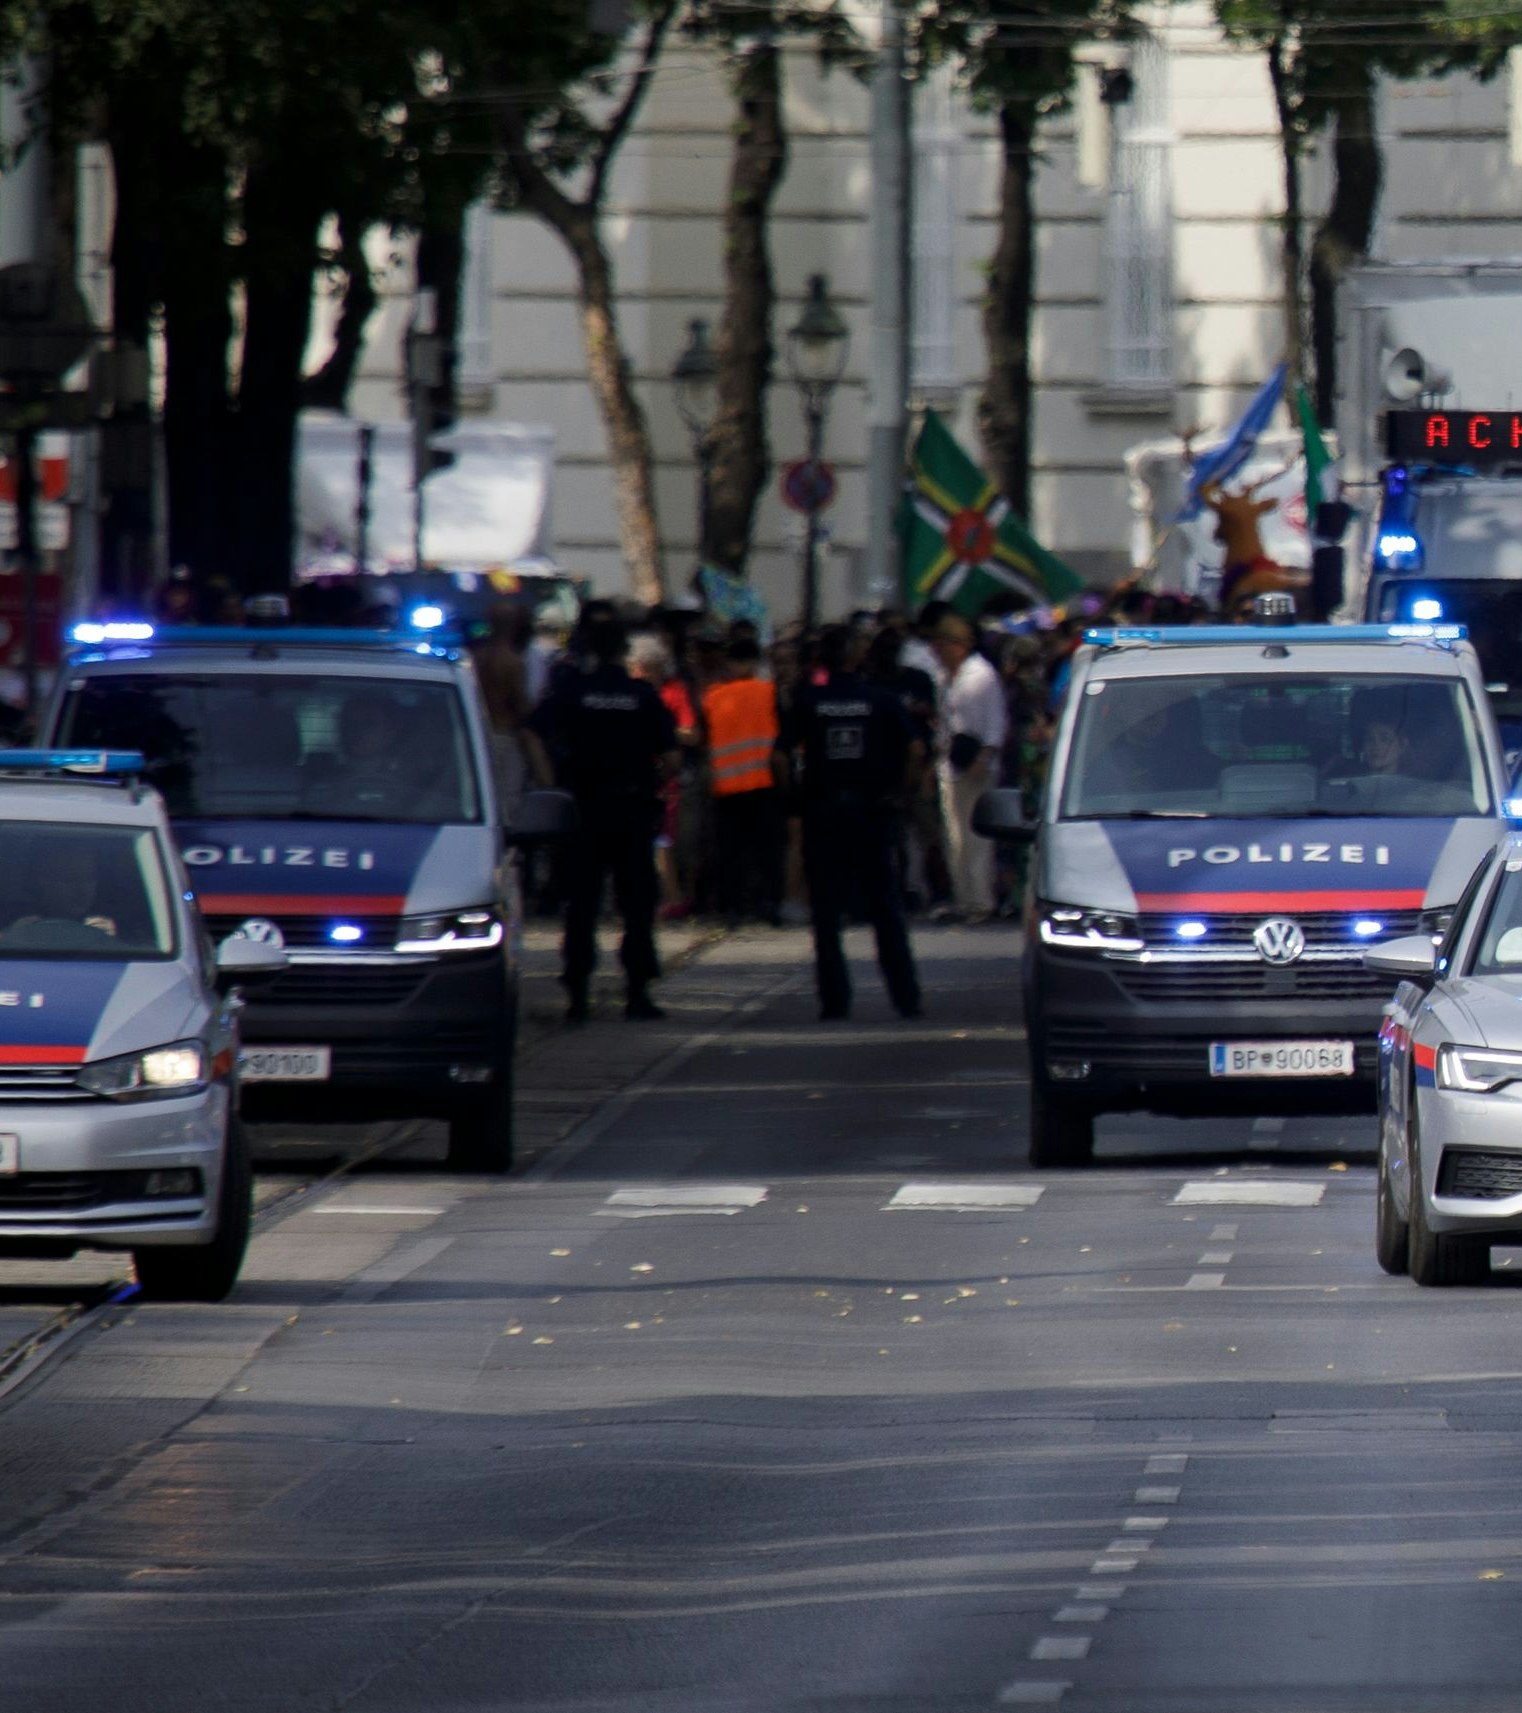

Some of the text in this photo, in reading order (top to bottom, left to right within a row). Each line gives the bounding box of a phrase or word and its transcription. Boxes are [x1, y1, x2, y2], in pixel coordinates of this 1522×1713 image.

[182, 845, 374, 870] OLIZEI
[1168, 843, 1389, 868] POLIZEI
[1233, 1050, 1258, 1070] BP
